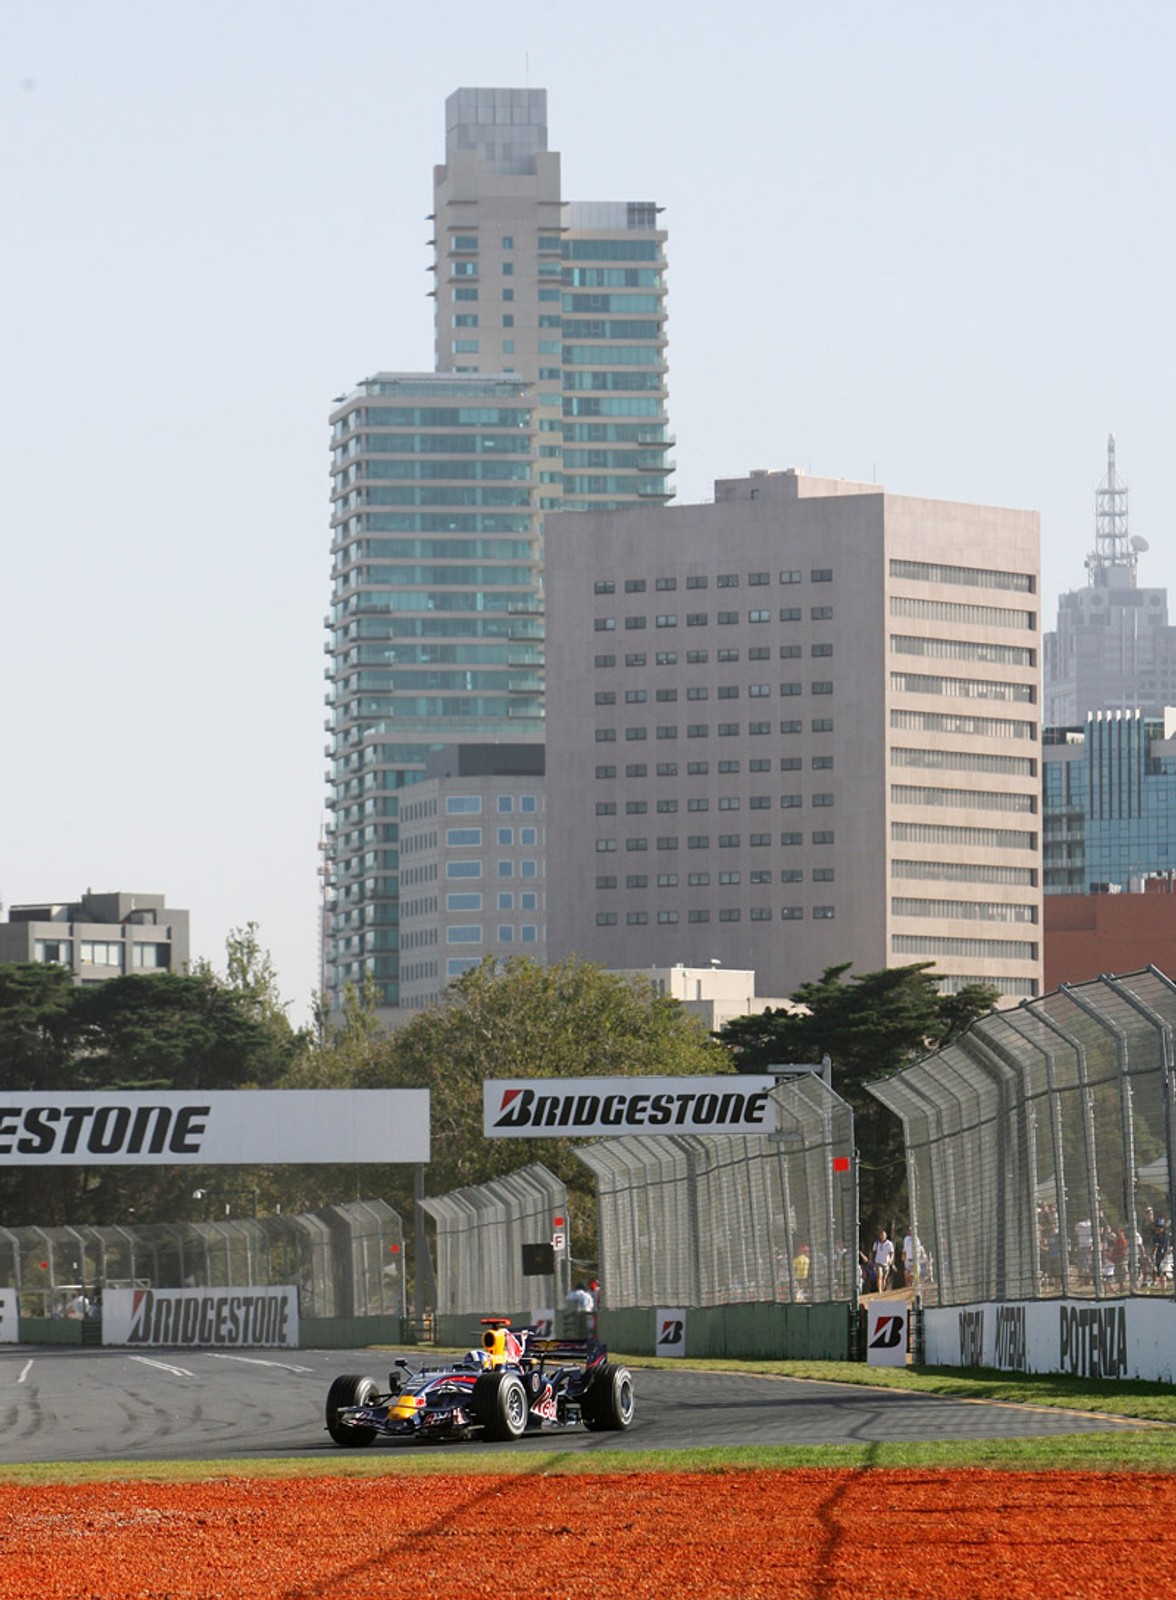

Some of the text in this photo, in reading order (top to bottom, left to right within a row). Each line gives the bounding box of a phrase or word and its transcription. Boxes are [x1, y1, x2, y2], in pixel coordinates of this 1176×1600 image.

[0, 1106, 211, 1154] ESTONE
[493, 1089, 769, 1127] BRIDGESTONE
[555, 1235, 562, 1248] F
[127, 1290, 289, 1343] BRIDGESTONE
[1060, 1305, 1127, 1379] POTENZA
